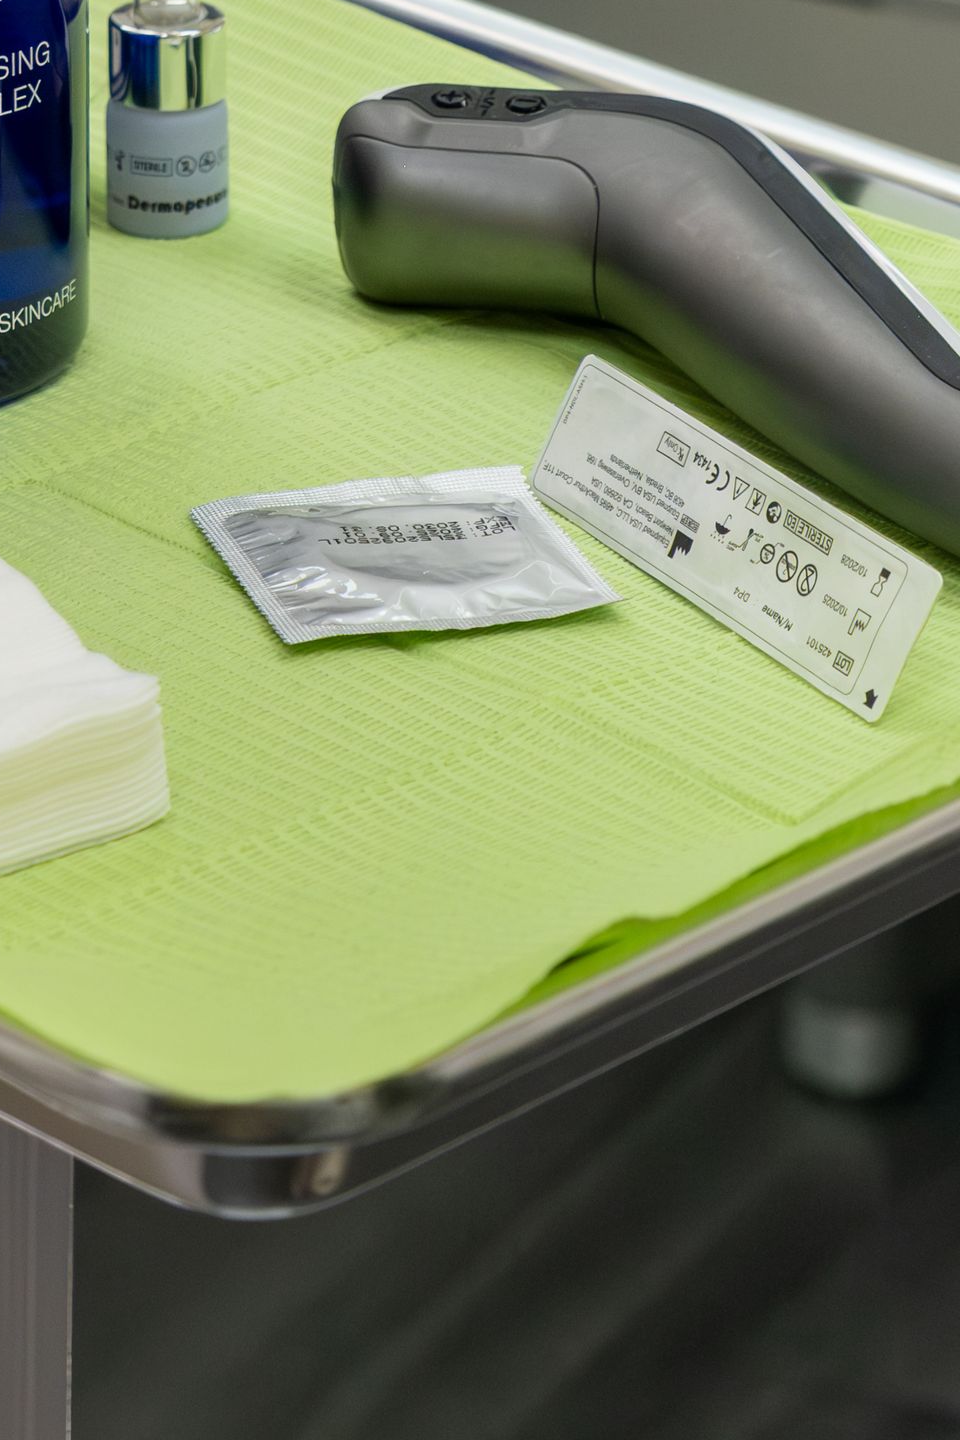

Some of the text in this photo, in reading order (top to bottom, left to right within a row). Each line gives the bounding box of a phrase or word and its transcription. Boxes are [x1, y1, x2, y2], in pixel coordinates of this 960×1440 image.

[664, 437, 678, 452] Only
[693, 452, 711, 471] 1434
[555, 469, 573, 484] Court
[591, 477, 602, 489] USA
[623, 497, 633, 508] CA
[629, 517, 642, 530] USA
[783, 514, 833, 551] STERILE EO
[733, 586, 793, 631] M/Name DP4
[835, 656, 851, 671] LOT
